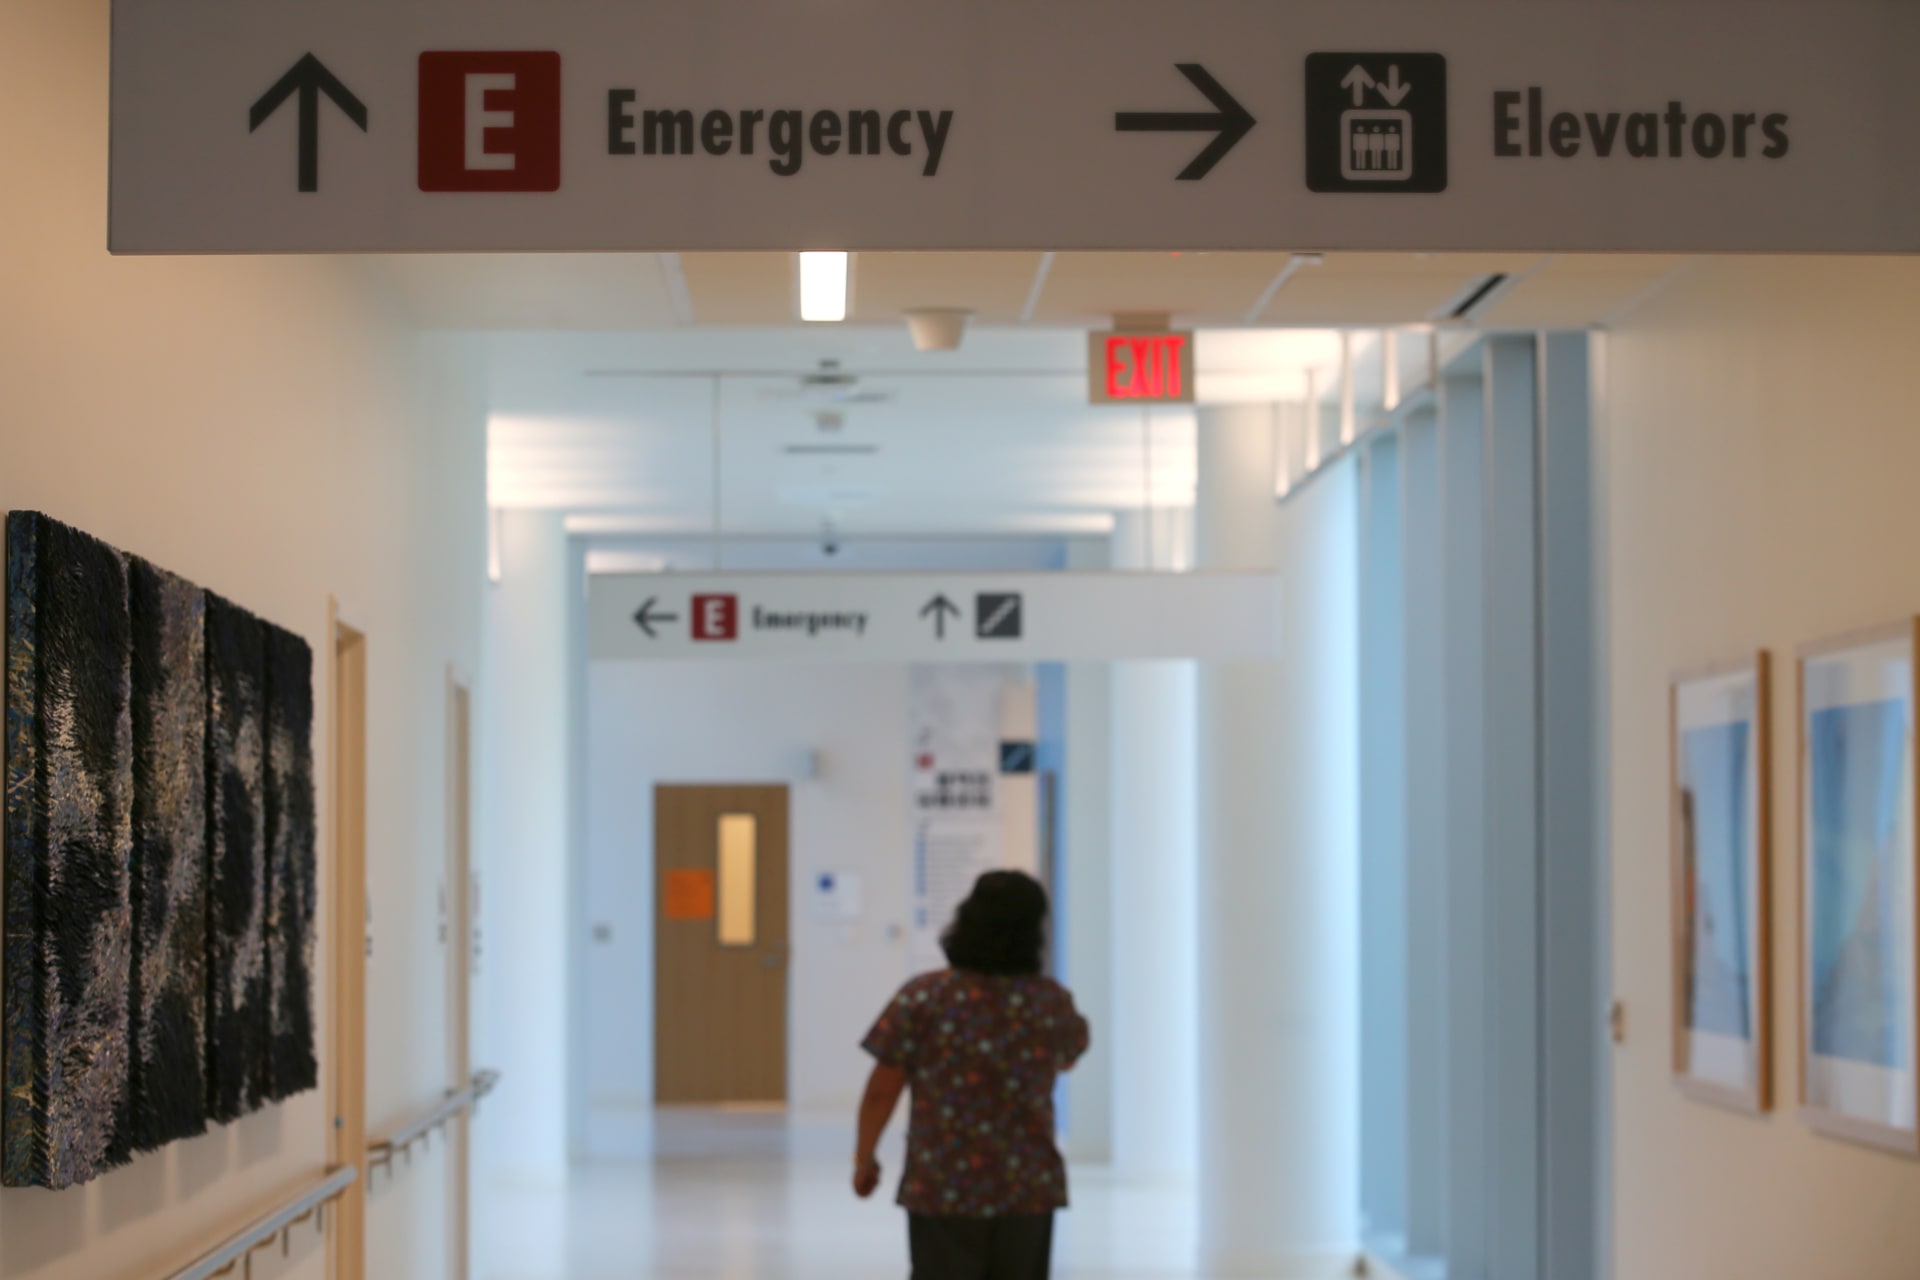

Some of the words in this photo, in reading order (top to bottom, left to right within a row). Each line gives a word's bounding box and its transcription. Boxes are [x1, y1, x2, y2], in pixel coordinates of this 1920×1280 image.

[464, 72, 517, 171] E
[606, 88, 954, 177] Emergency
[1493, 86, 1790, 160] Elevators
[1105, 336, 1185, 398] EXIT
[704, 599, 726, 636] E
[752, 605, 868, 637] Emergency
